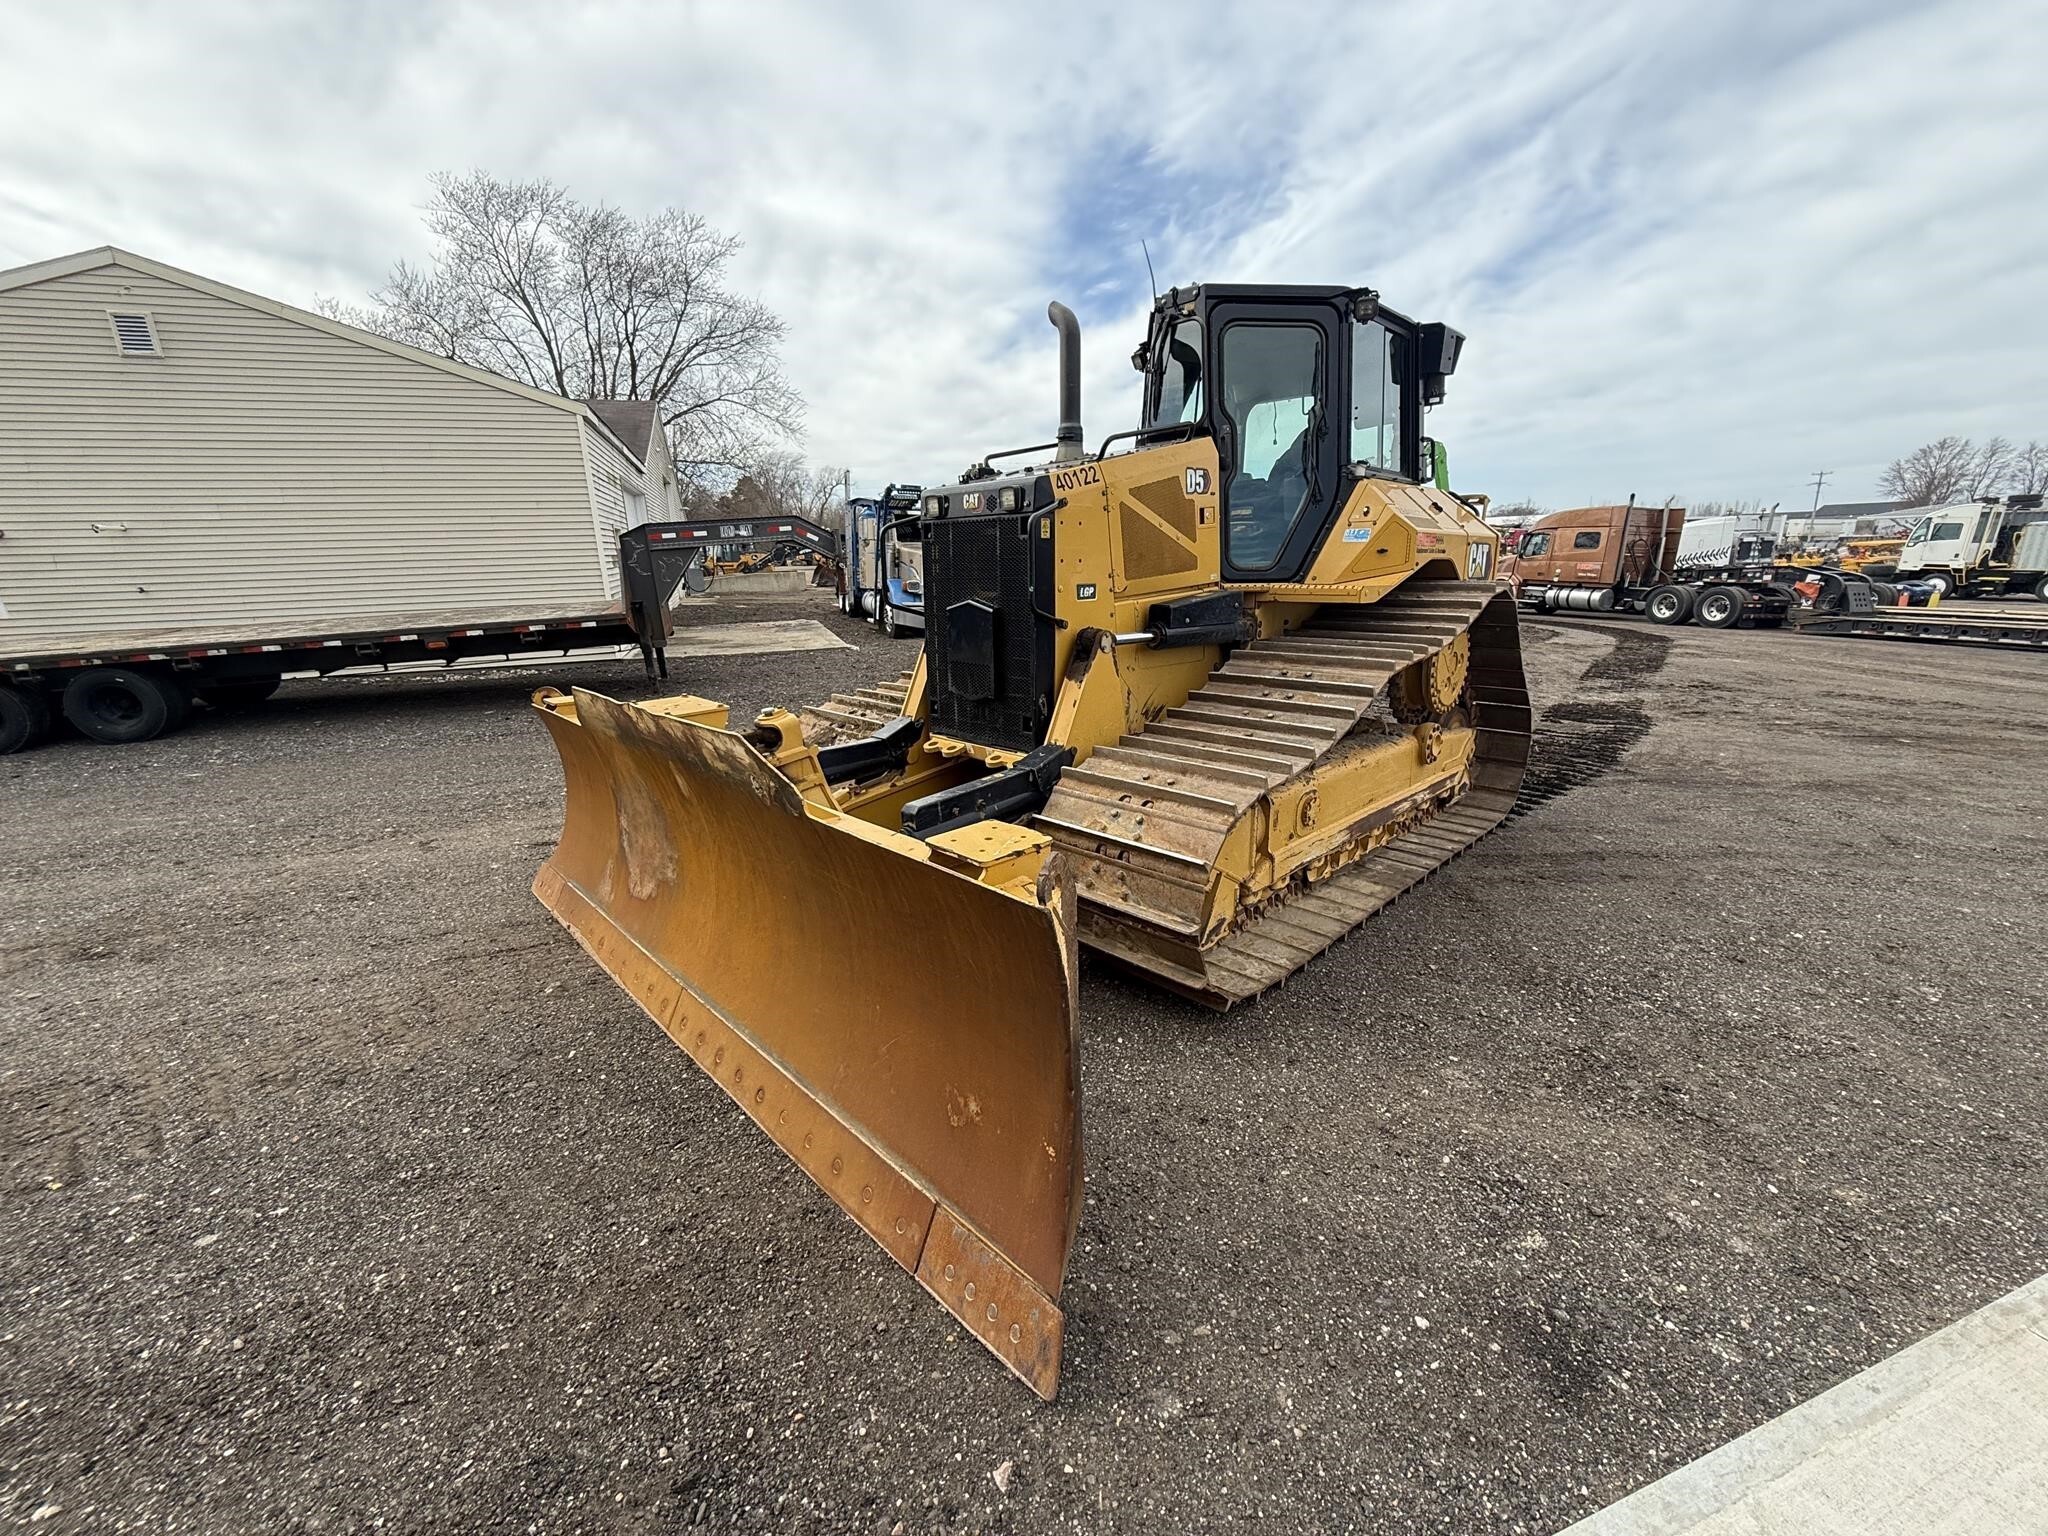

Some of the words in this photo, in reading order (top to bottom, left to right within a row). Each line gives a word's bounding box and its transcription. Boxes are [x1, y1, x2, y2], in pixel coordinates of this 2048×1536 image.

[1056, 465, 1100, 491] 40122
[1186, 468, 1205, 494] D5
[963, 493, 979, 509] CAT
[1469, 543, 1489, 578] CAT
[1080, 586, 1094, 598] LGP
